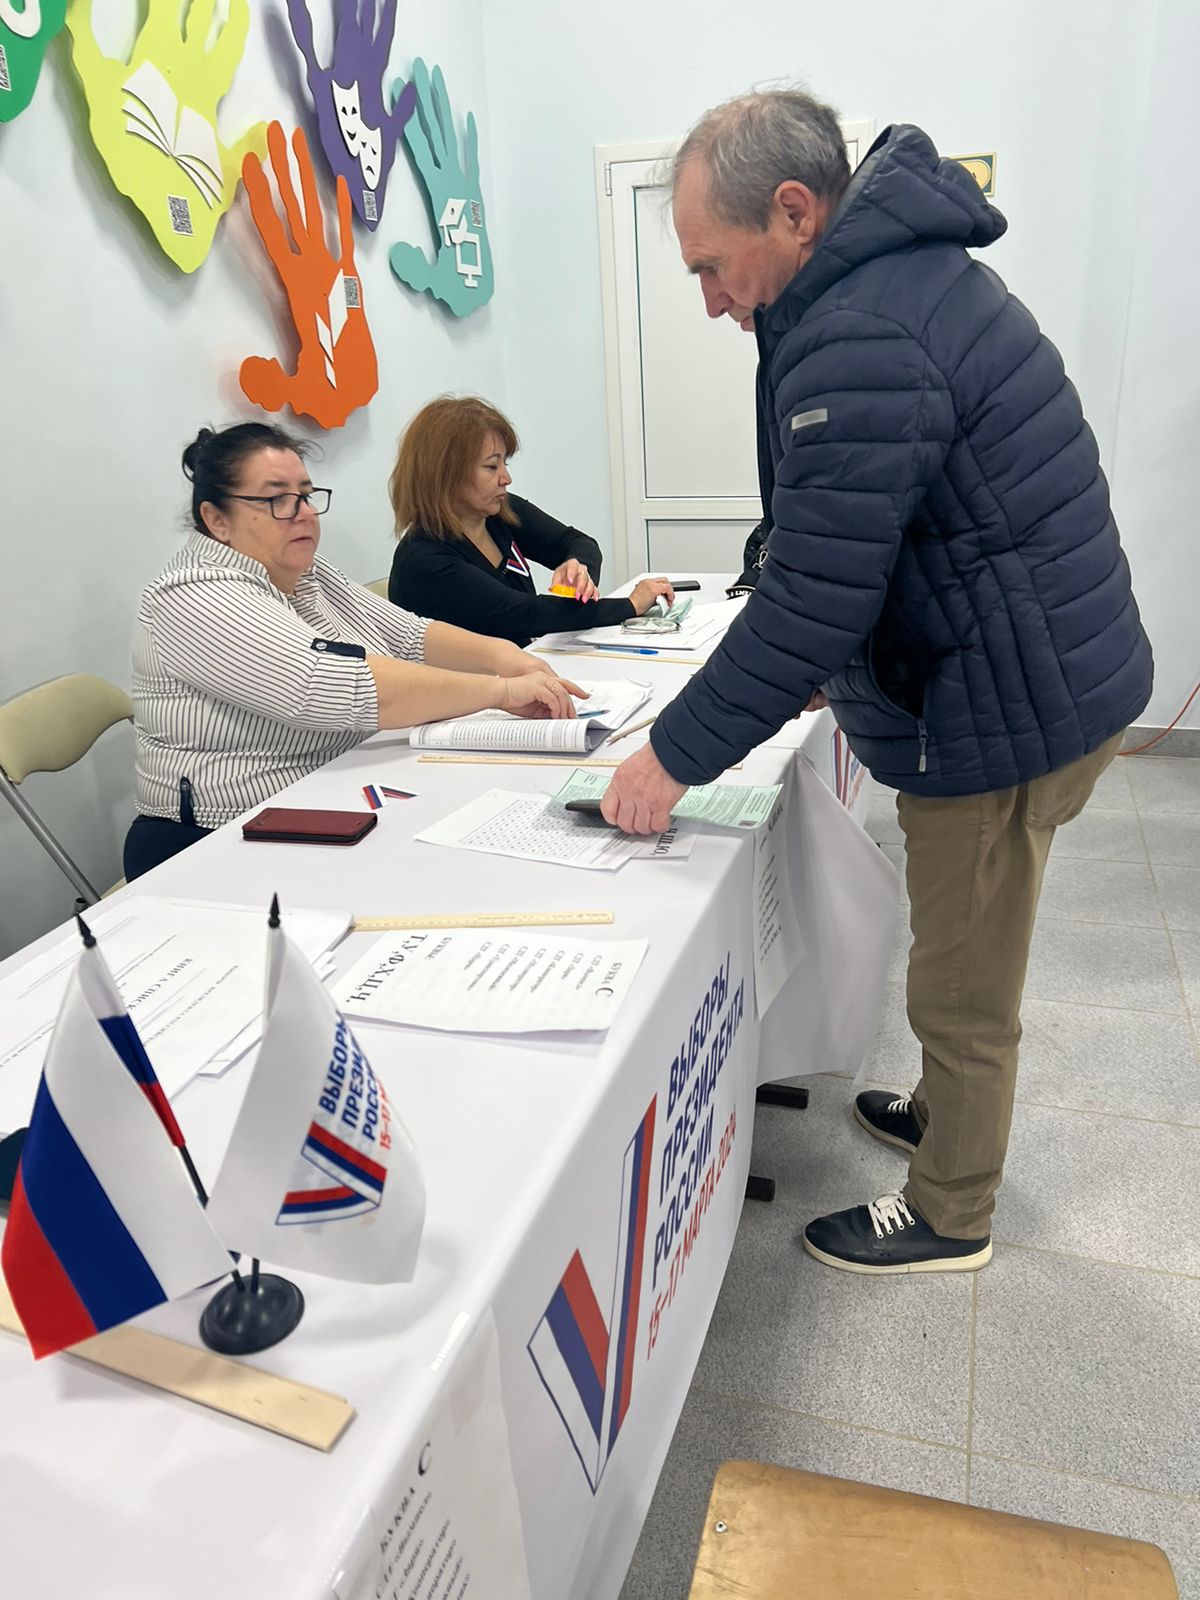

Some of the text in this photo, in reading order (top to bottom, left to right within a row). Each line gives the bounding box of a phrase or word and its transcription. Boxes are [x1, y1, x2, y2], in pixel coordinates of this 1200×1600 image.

[126, 983, 161, 1011] СПИСК
[666, 950, 731, 1123] ВЫБОРЫ
[362, 1073, 379, 1142] РОСС
[659, 977, 744, 1208] ПРЕЗИДЕНТА
[652, 1103, 714, 1293] РОССИИ
[682, 1158, 715, 1276] МАРТА
